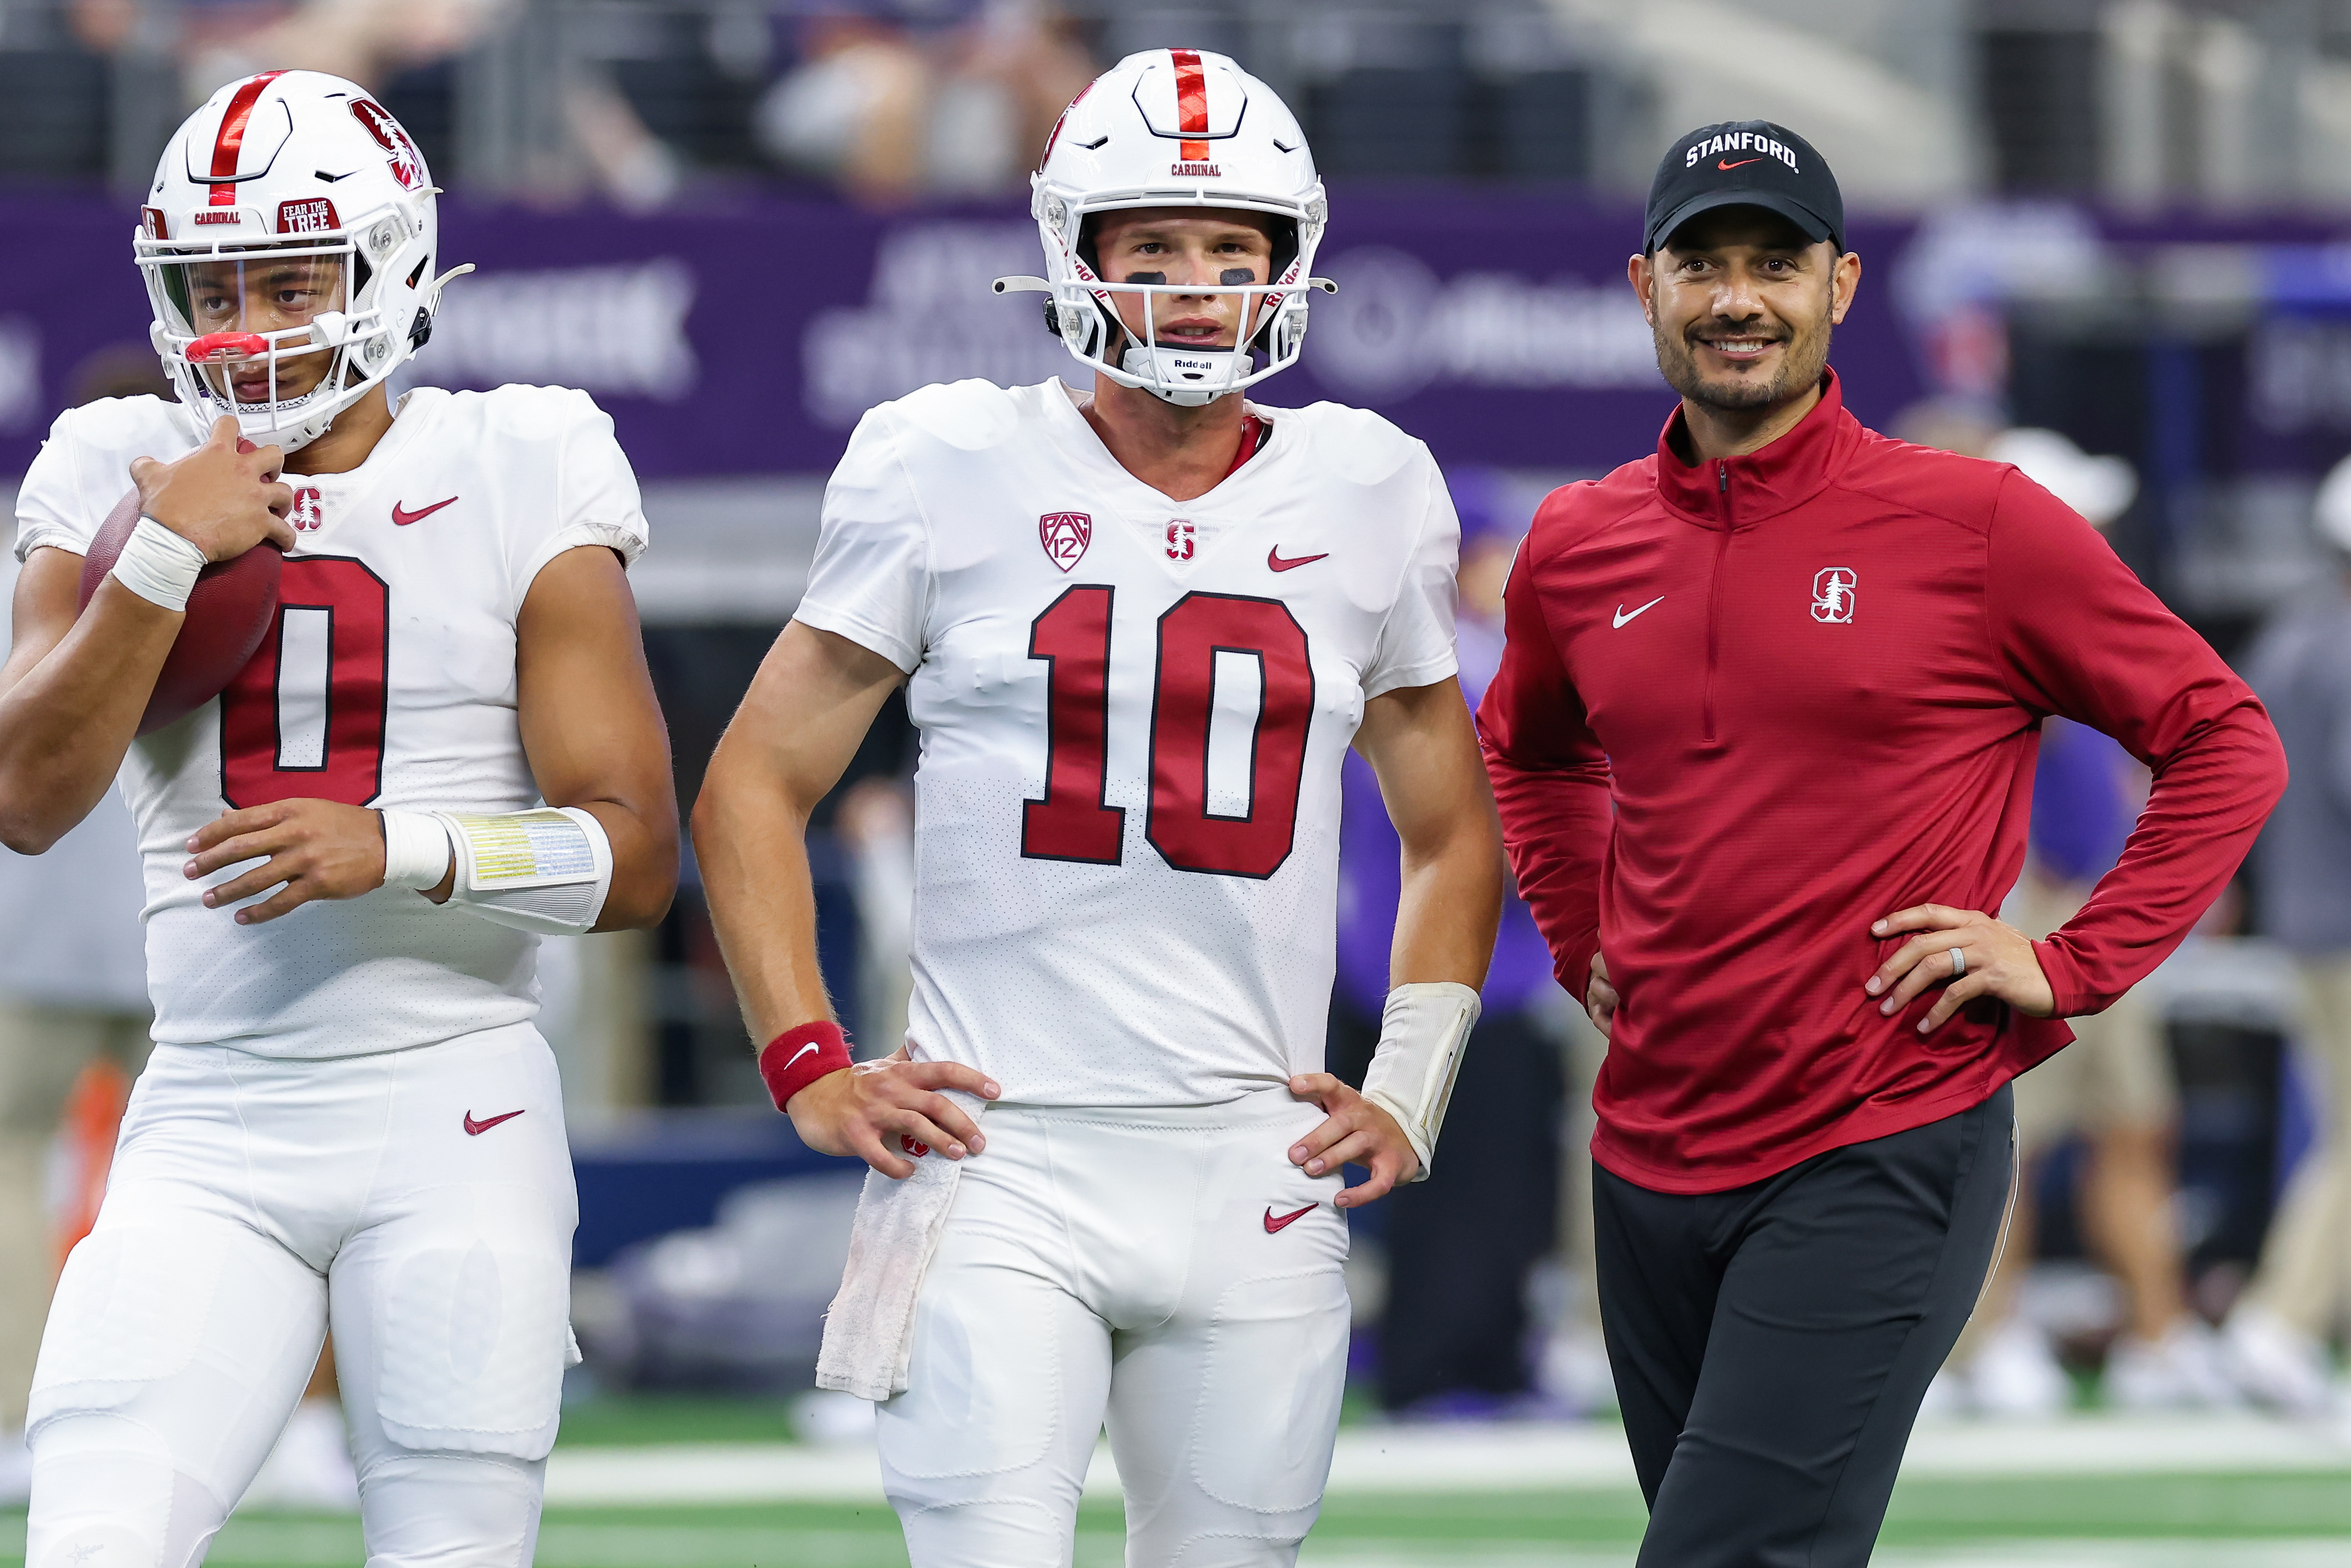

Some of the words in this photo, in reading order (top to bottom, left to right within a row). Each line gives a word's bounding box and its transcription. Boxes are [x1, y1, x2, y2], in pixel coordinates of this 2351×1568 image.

[1686, 132, 1797, 169] STANFORD
[1172, 164, 1221, 176] CARDINAL
[195, 212, 240, 225] CARDINAL
[283, 203, 307, 217] FEAR
[309, 200, 328, 213] THE
[284, 211, 330, 233] TREE
[1175, 360, 1212, 369] Riddell
[1043, 515, 1088, 548] PAC
[1054, 538, 1078, 558] 12
[220, 554, 389, 810] 0
[1020, 583, 1315, 880] 10
